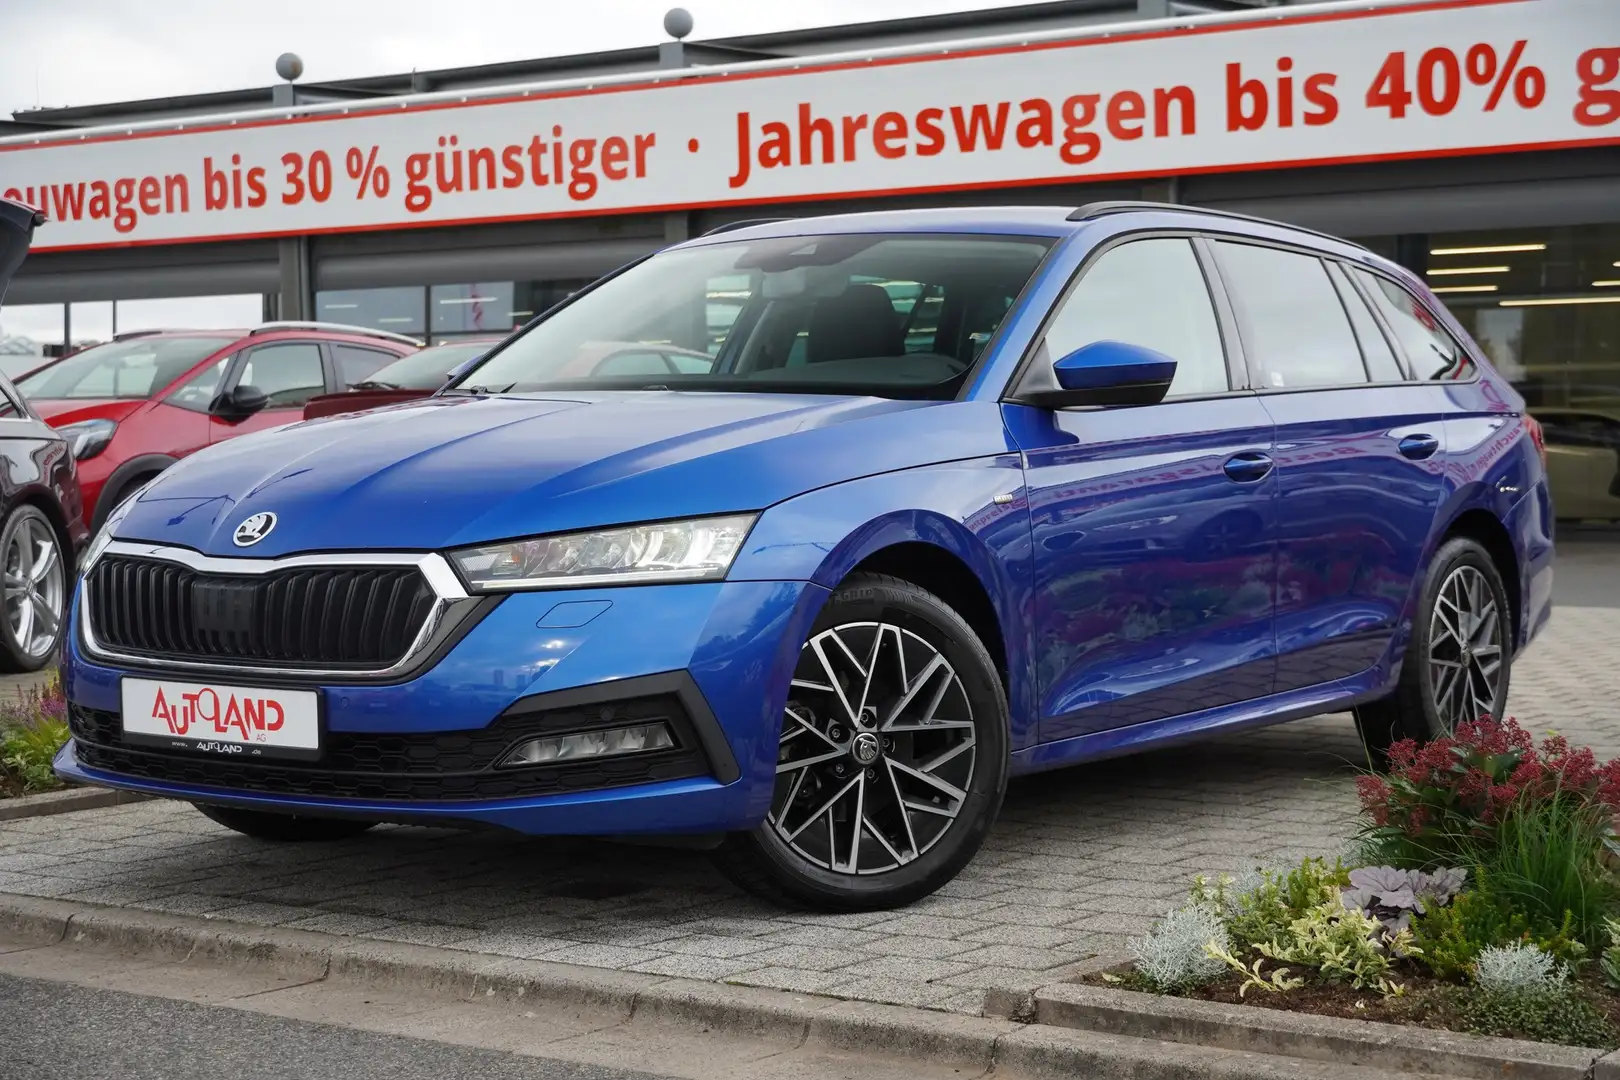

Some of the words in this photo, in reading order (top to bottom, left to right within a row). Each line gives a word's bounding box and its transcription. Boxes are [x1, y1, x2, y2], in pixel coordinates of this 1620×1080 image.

[203, 153, 267, 211] bis
[281, 149, 332, 206] 30
[345, 145, 391, 200] %
[404, 124, 657, 214] günstiger
[728, 85, 1197, 190] Jahreswagen
[1225, 56, 1340, 133] bis
[1365, 39, 1547, 120] 40%
[152, 686, 285, 741] AUTOLAND
[196, 741, 243, 754] AUTOLAND
[256, 733, 267, 743] AG
